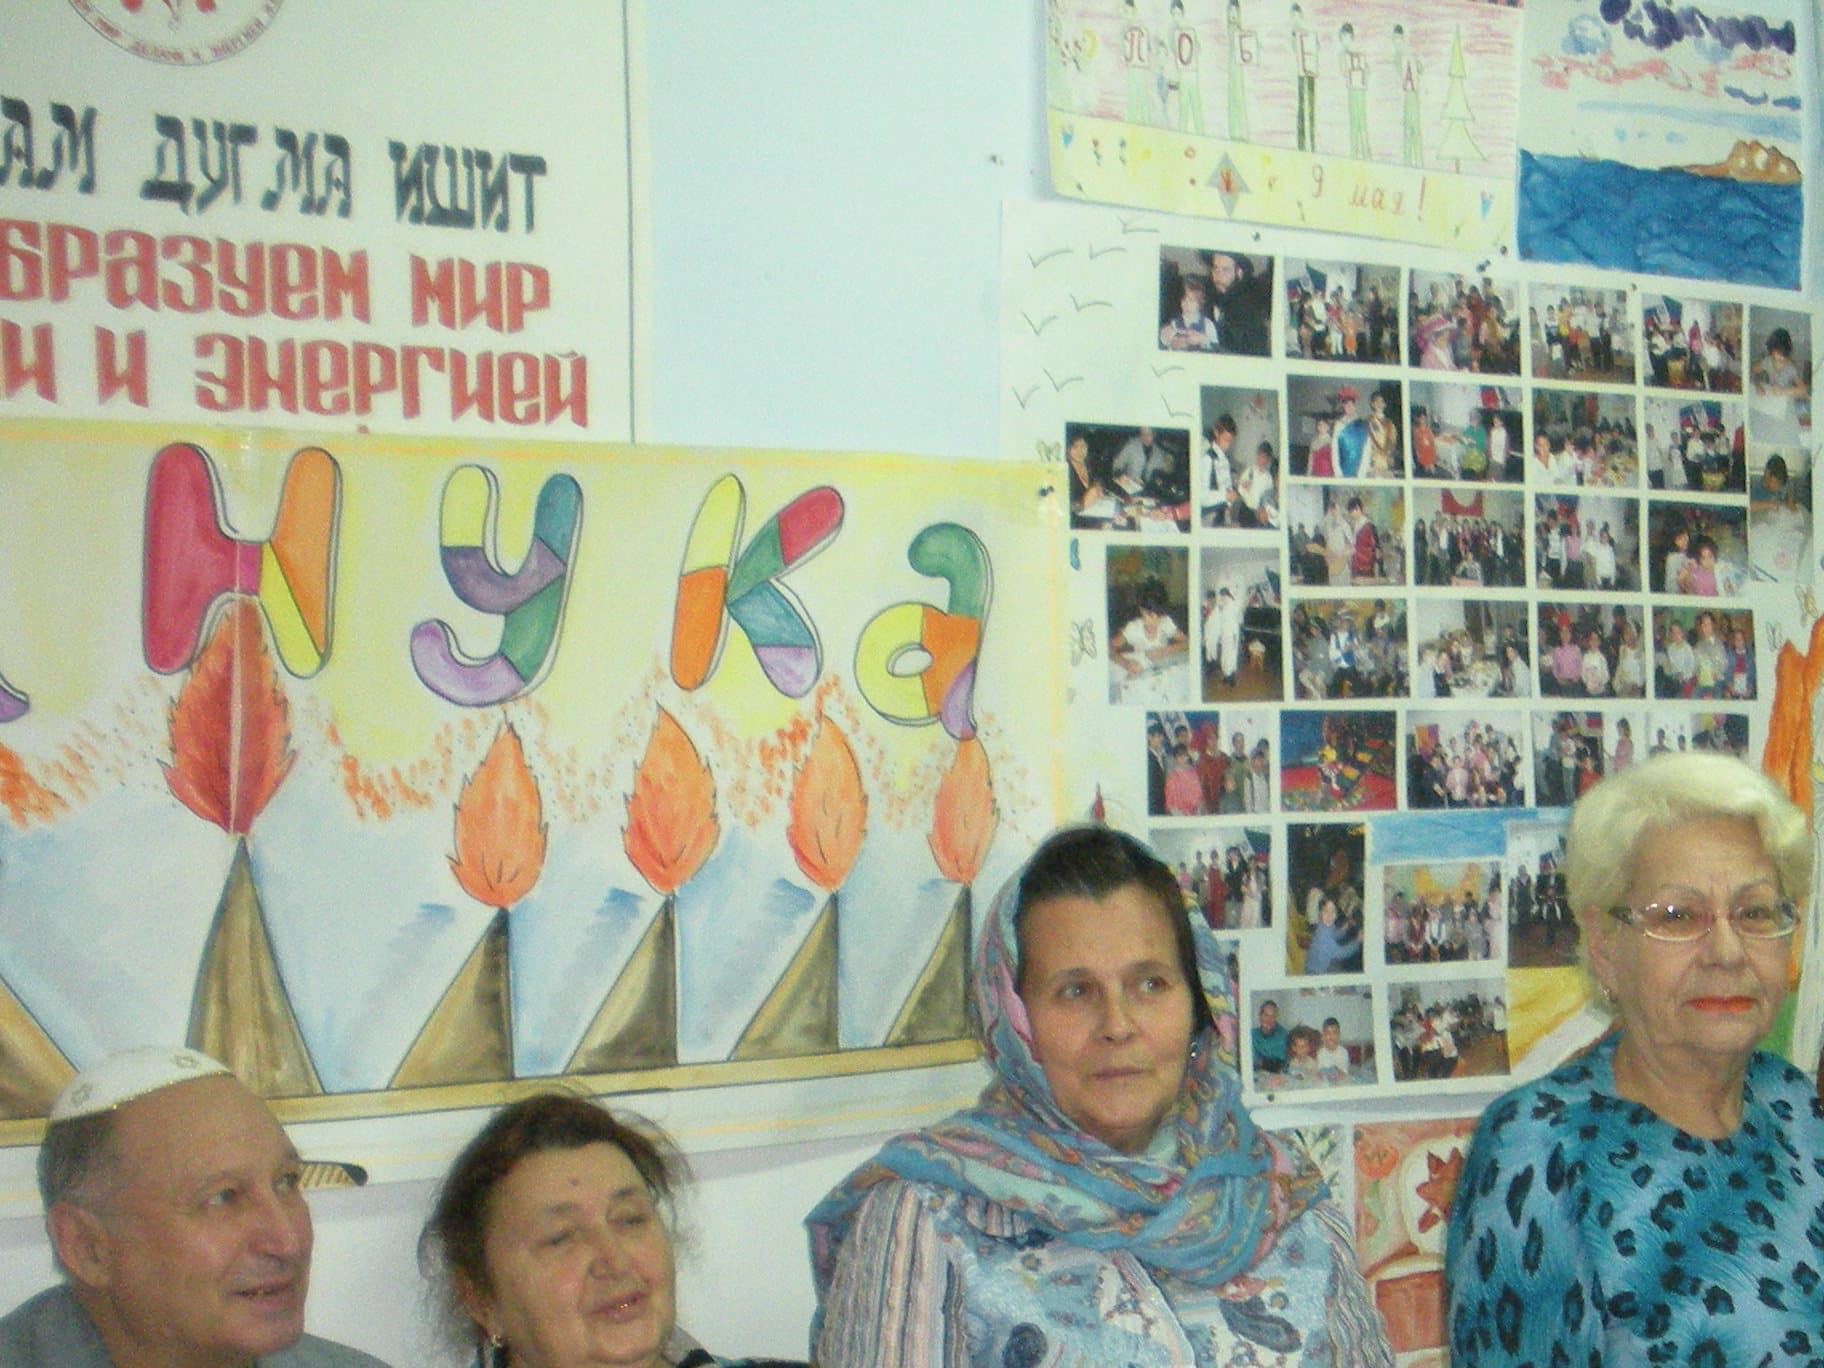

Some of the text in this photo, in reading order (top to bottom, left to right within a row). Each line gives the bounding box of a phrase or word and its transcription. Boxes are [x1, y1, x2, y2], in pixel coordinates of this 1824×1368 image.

[388, 137, 547, 234] ИШИТ
[410, 252, 551, 334] мир
[95, 325, 149, 408] и
[194, 332, 589, 428] энергией
